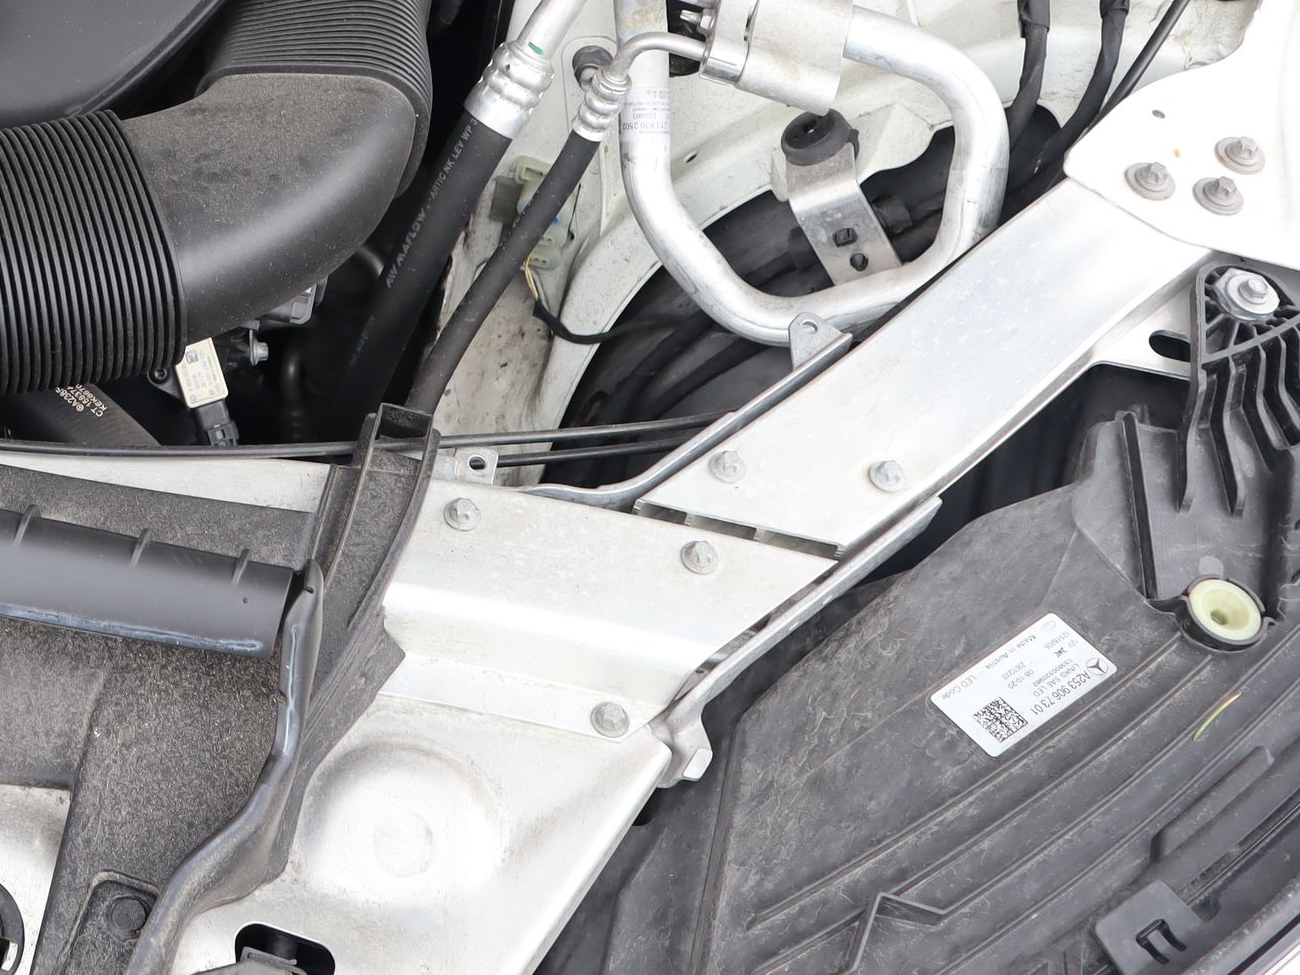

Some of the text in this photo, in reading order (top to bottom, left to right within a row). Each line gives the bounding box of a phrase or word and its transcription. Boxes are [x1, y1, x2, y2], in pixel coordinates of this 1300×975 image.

[444, 158, 455, 174] NK
[91, 407, 103, 417] CT
[985, 652, 1009, 670] Austria
[1060, 663, 1080, 678] LINKS
[941, 674, 978, 700] LED Code
[1030, 671, 1091, 715] A253 906 73 01
[1033, 685, 1047, 697] LED
